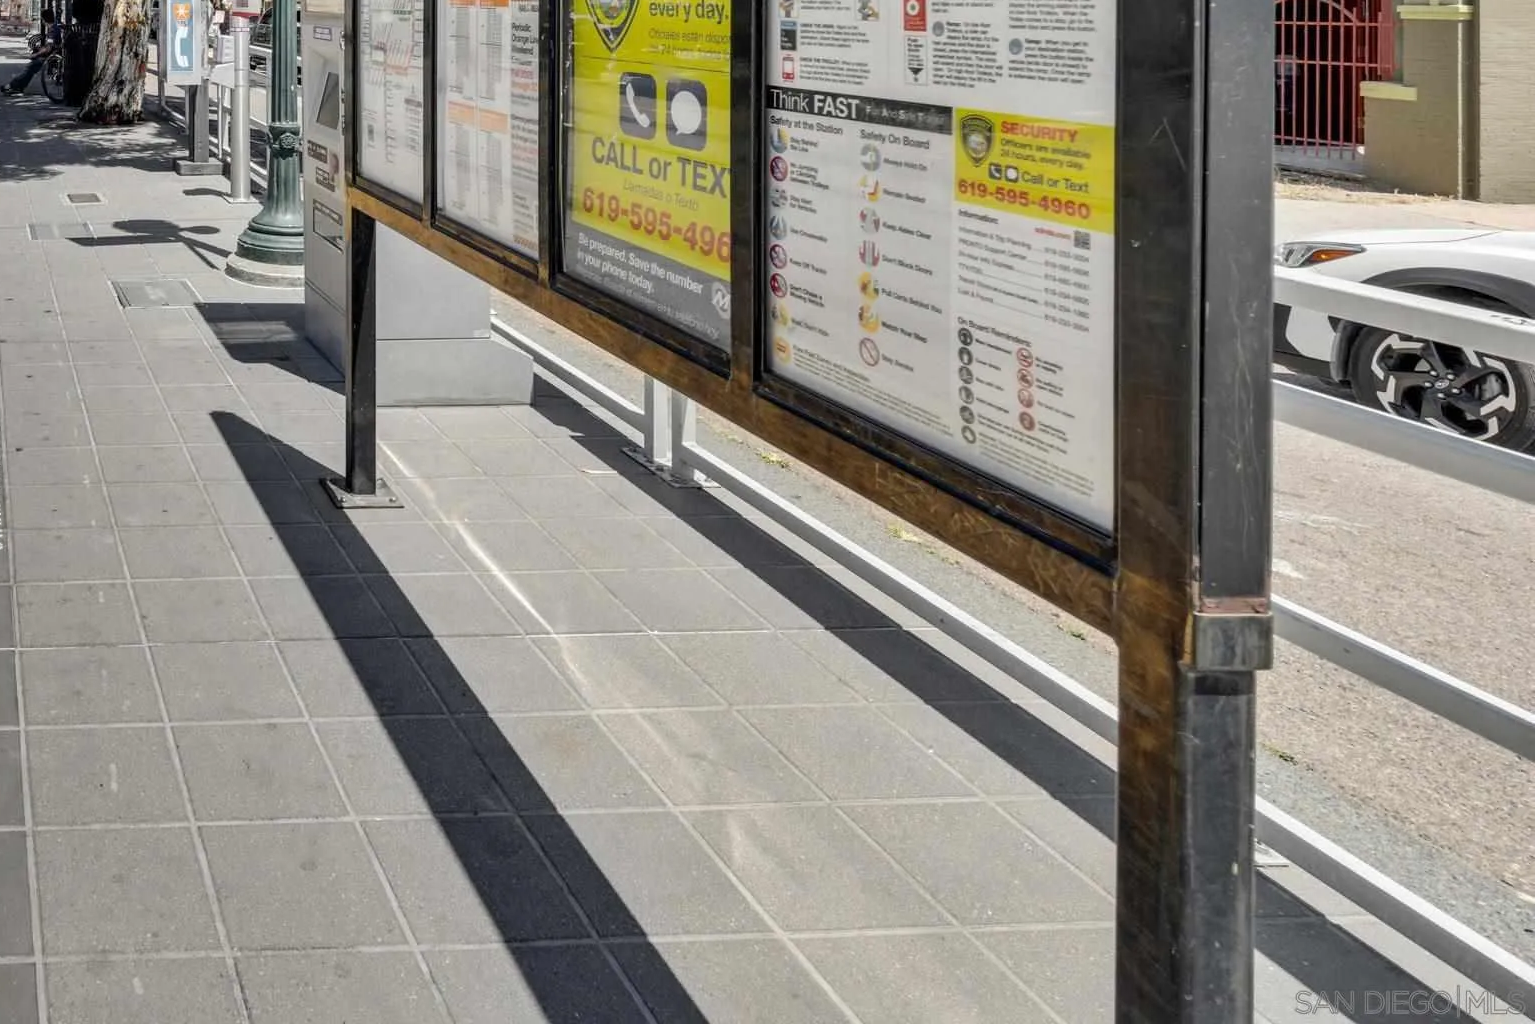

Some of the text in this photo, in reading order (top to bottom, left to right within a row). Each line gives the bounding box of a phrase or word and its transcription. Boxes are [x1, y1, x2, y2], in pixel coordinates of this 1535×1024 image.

[649, 0, 691, 23] every
[770, 89, 809, 113] Think
[814, 95, 860, 119] FAST
[770, 116, 843, 135] Safety at the Station
[1001, 121, 1079, 143] SECURITY
[860, 129, 930, 149] Safety On Board
[1001, 138, 1033, 151] Officers
[1051, 145, 1091, 159] available
[592, 137, 731, 198] CALL or TEX
[1039, 155, 1064, 168] every
[1021, 170, 1090, 193] Call or Text
[958, 179, 1090, 220] 619-595-4960
[578, 232, 588, 246] Be
[589, 238, 627, 263] prepared.
[629, 253, 650, 272] Save
[651, 262, 665, 279] the
[666, 270, 704, 294] number
[584, 253, 602, 268] your
[602, 260, 627, 280] phone
[629, 271, 654, 294] today.
